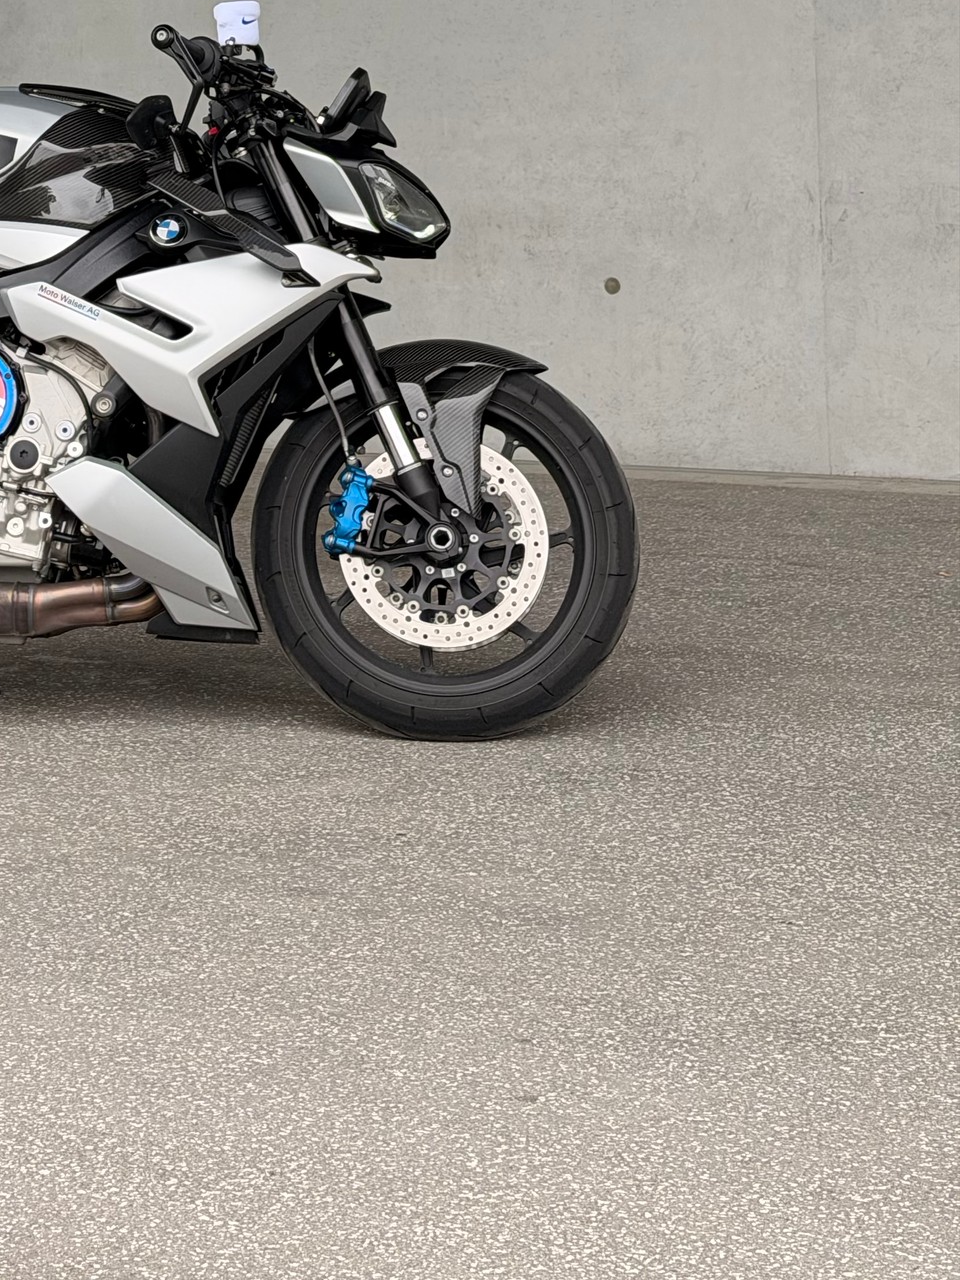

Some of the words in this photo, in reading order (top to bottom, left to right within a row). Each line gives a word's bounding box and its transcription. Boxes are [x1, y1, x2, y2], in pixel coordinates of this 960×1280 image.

[38, 284, 59, 299] Moto
[60, 293, 86, 311] Walser
[86, 306, 101, 317] AG
